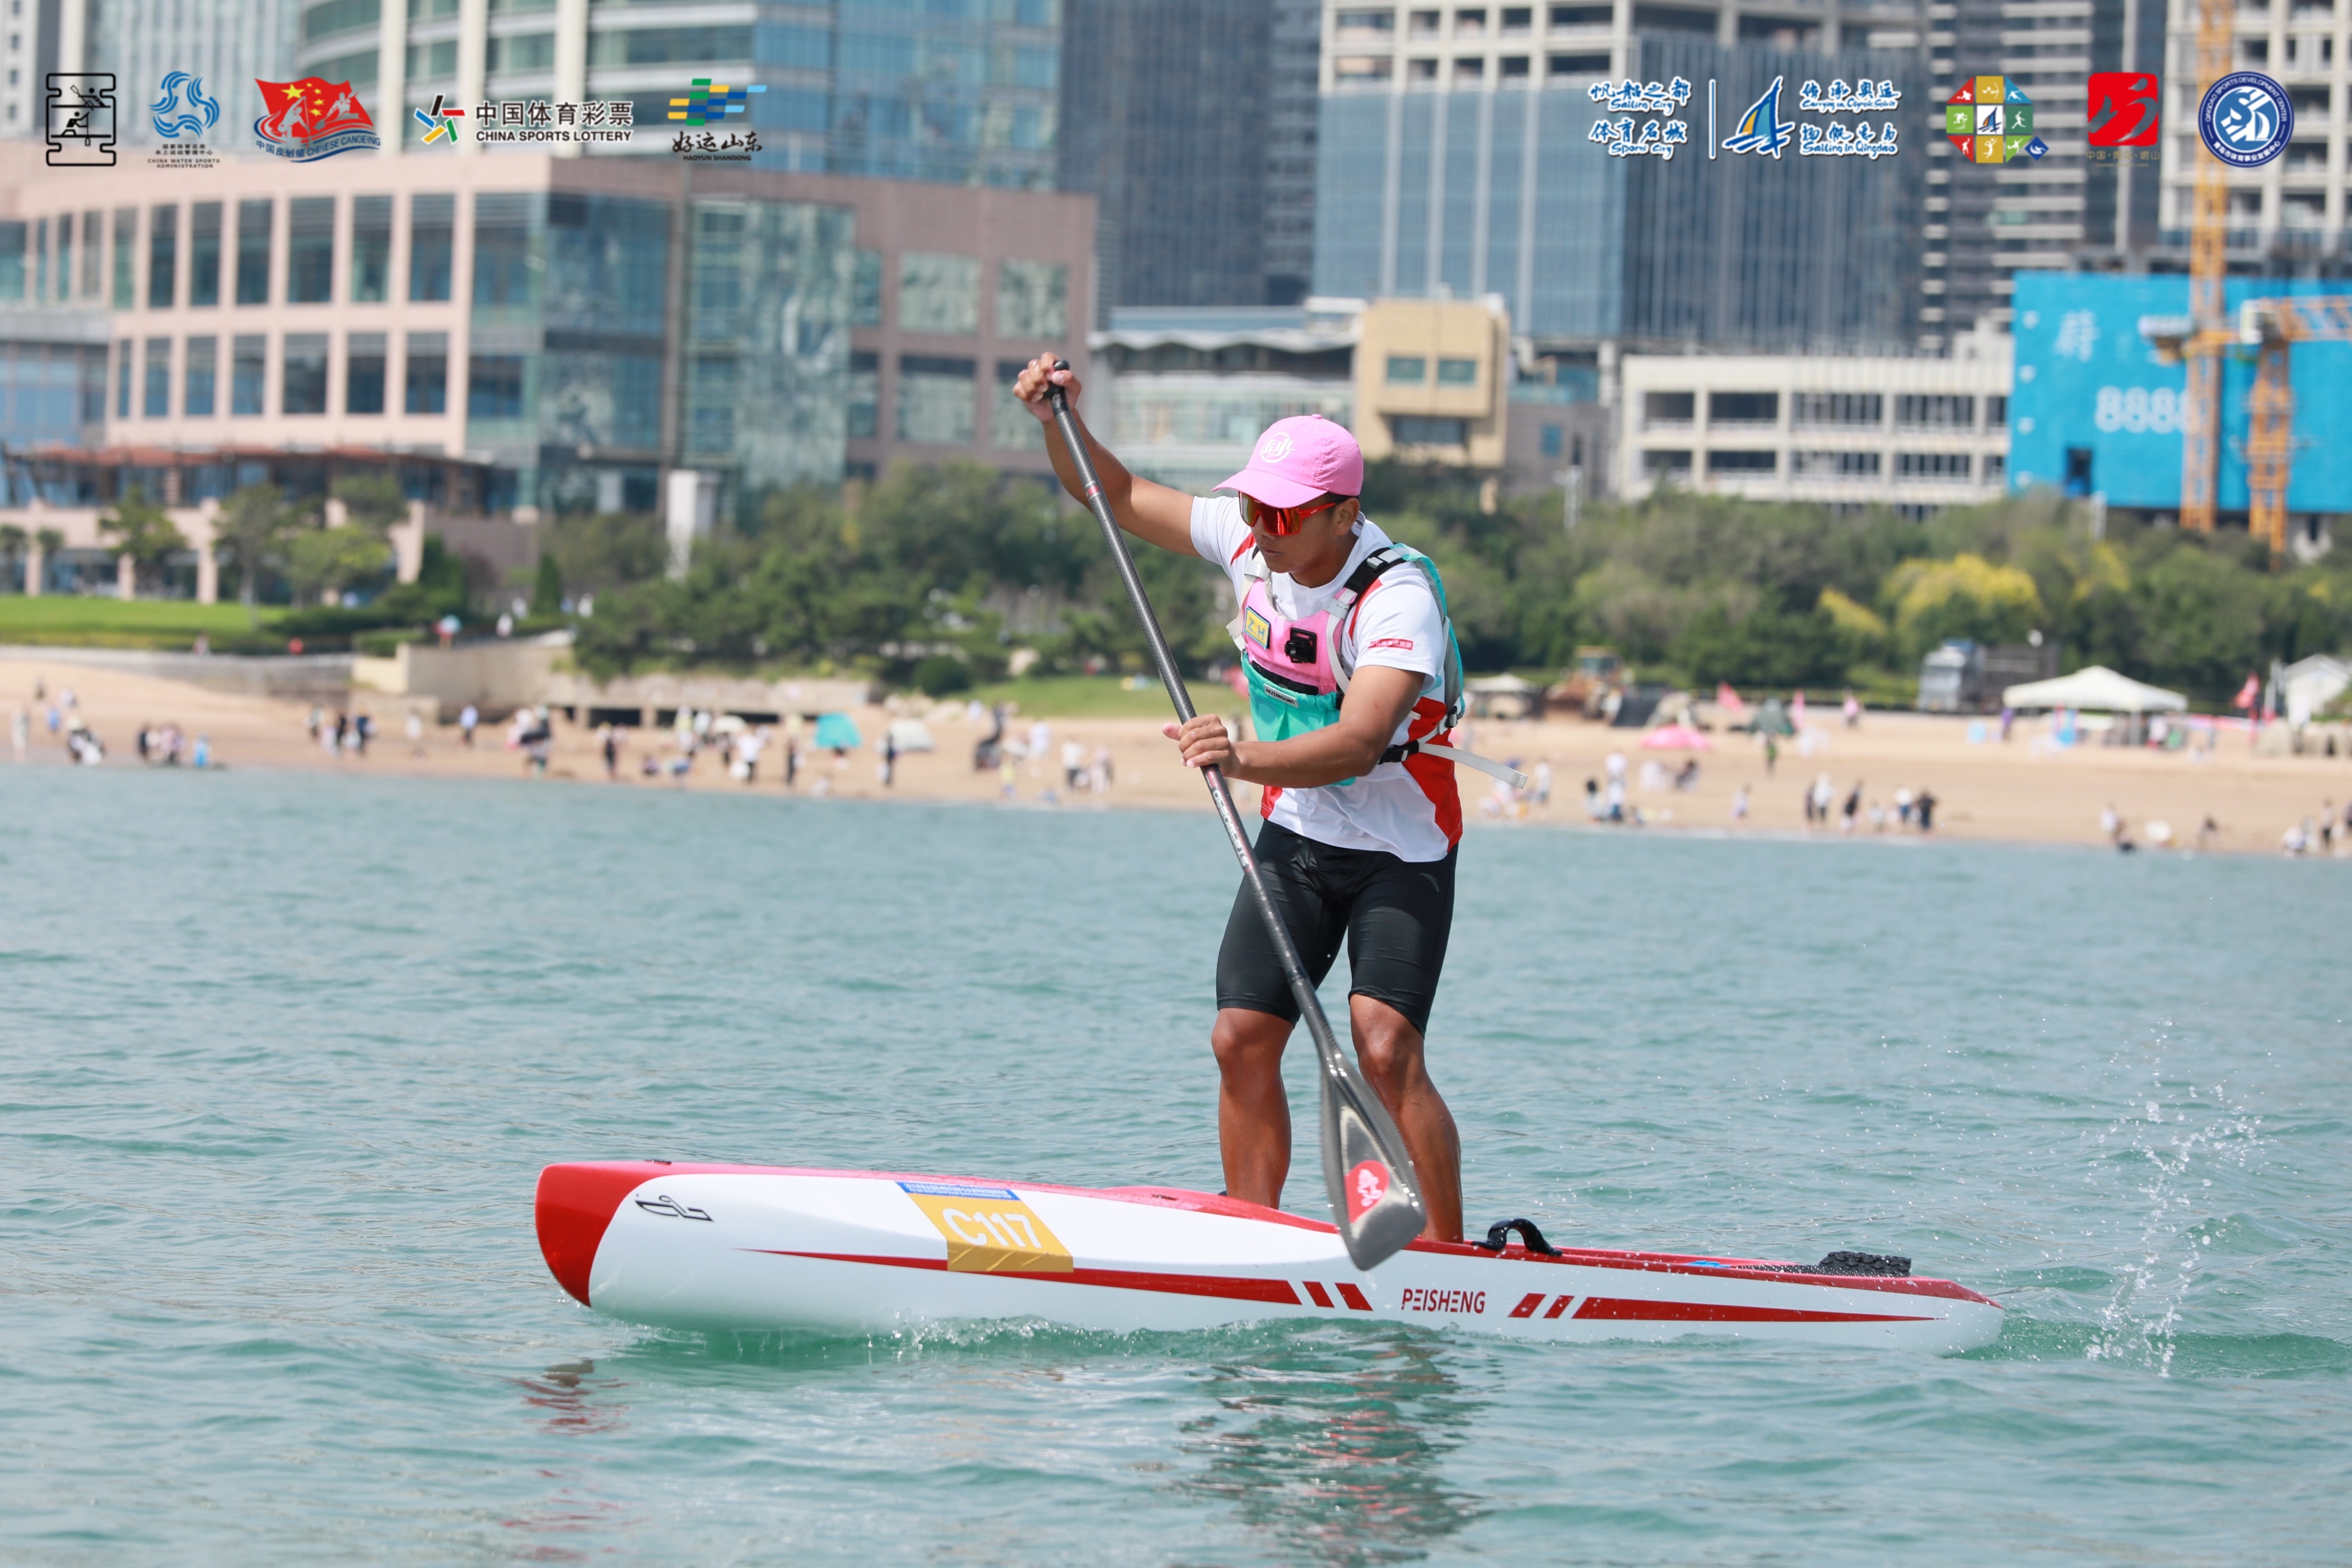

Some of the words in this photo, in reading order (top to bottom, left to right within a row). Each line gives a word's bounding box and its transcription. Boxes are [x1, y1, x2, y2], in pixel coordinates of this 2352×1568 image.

[1247, 616, 1266, 641] Z.H
[1266, 688, 1296, 705] HUIMOUNT
[942, 1207, 1043, 1249] C117
[1401, 1288, 1486, 1314] PEISHENG
